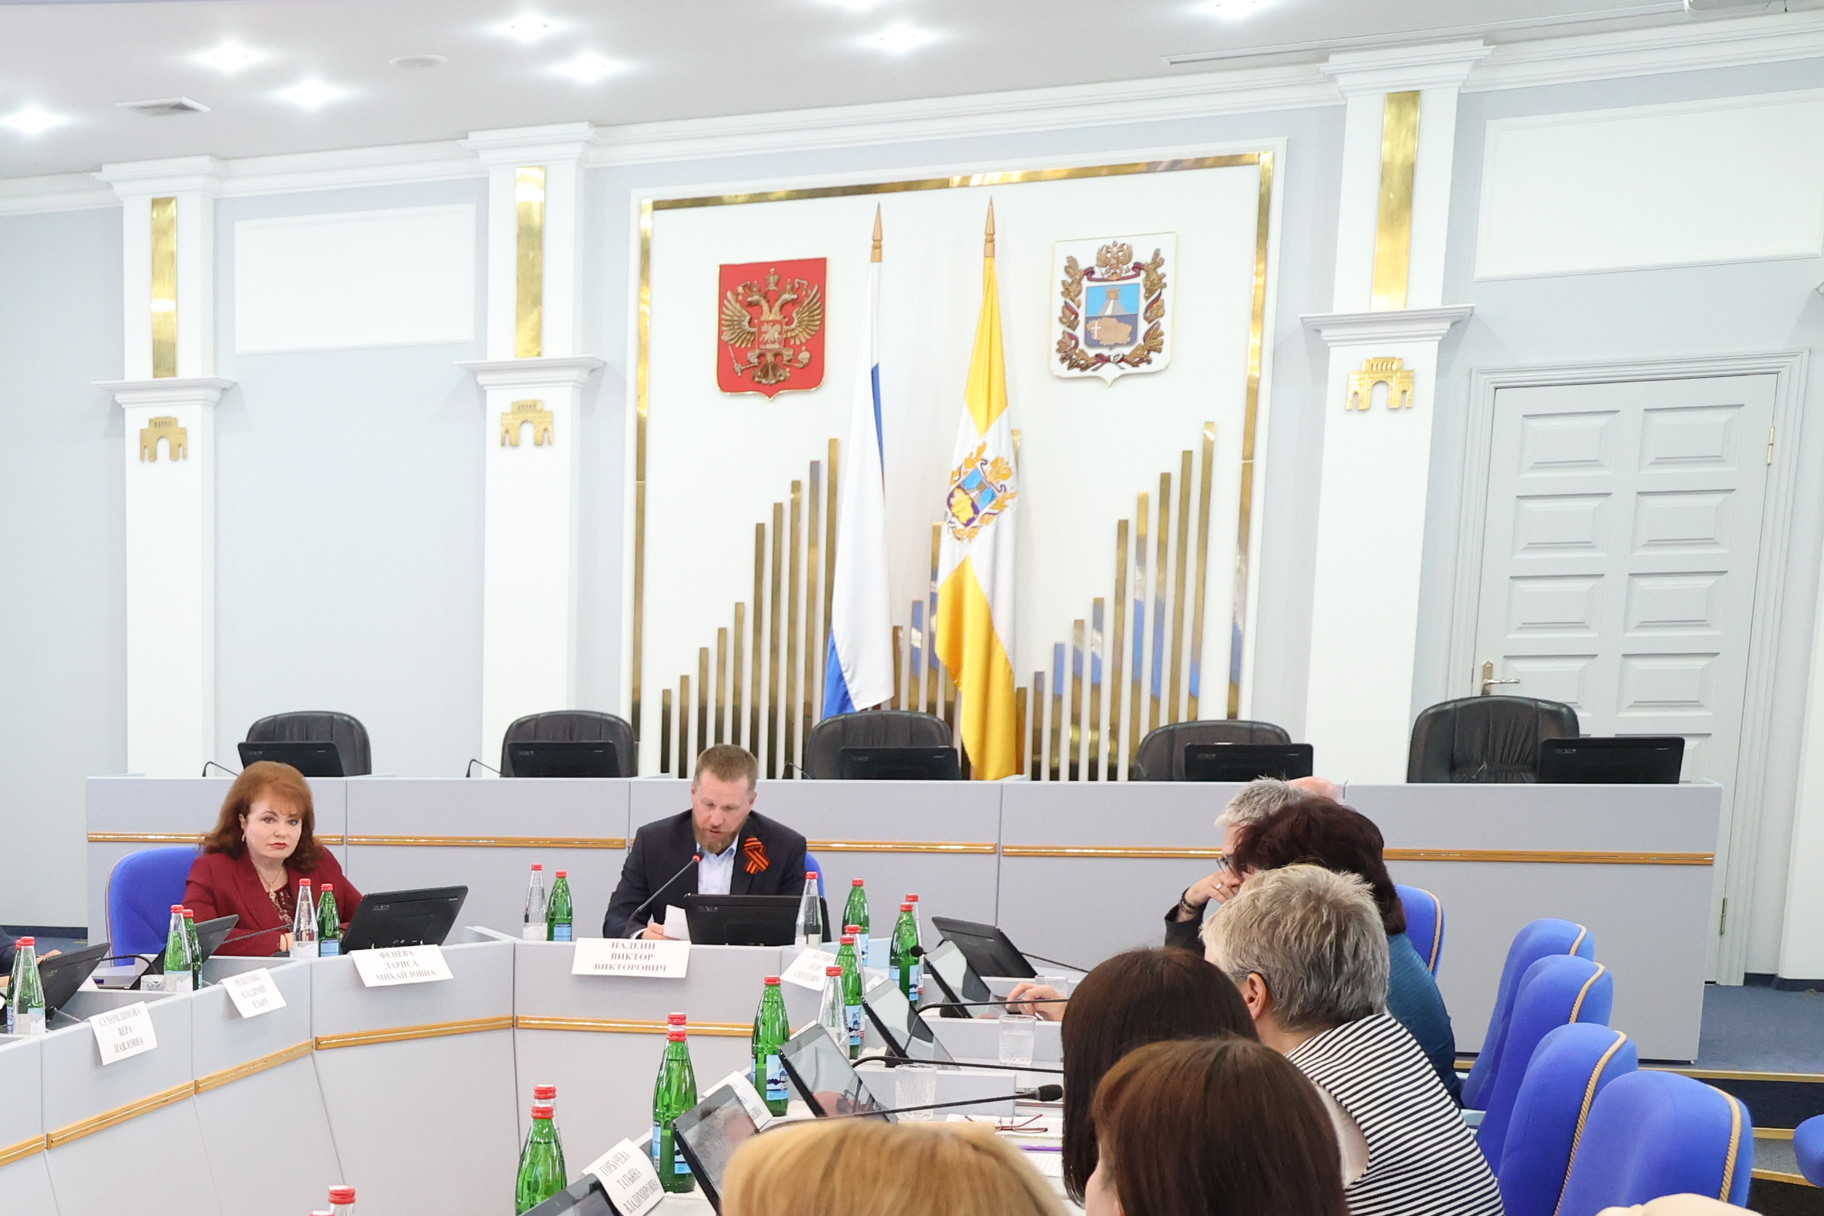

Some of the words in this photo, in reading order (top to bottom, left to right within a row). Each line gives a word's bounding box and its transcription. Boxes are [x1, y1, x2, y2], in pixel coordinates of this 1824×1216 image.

[379, 950, 415, 959] ФЕНЕВА
[610, 952, 654, 961] ВИКТОР
[385, 960, 419, 970] ЛАРИСА
[594, 963, 667, 972] ВИКТОРОВИЧ
[375, 969, 437, 981] МИХАЙЛОВНА
[616, 1167, 644, 1190] ТАТЬЯНА
